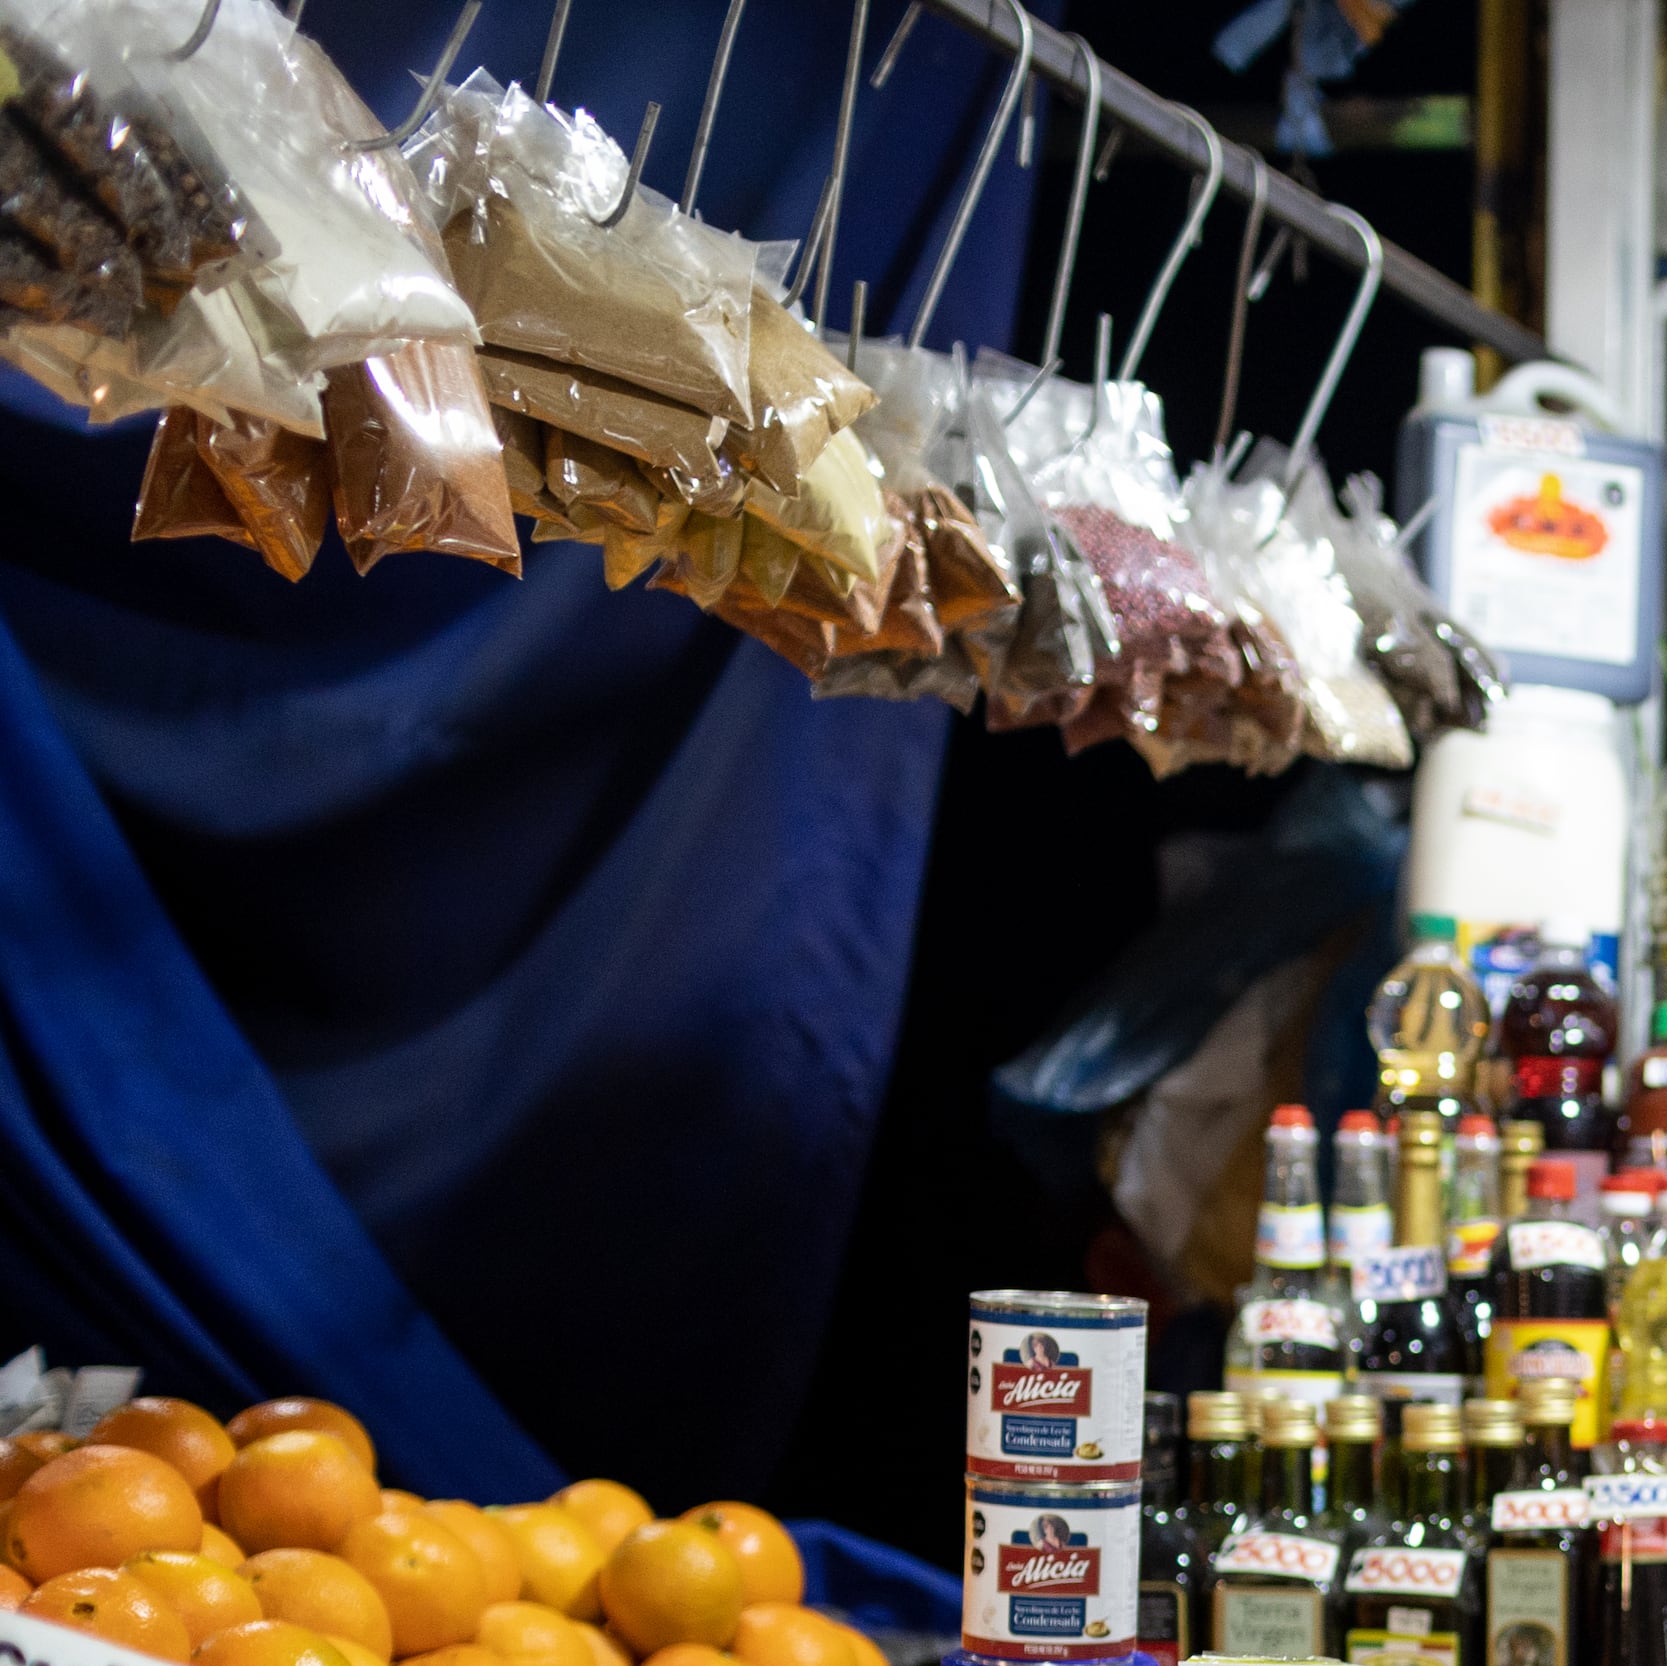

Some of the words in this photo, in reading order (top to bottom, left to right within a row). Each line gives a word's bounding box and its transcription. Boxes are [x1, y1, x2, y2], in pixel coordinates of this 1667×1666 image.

[1003, 1372, 1082, 1405] Alicia
[1005, 1432, 1071, 1449] Condensada
[1011, 1552, 1090, 1588] Alicia
[1013, 1612, 1081, 1628] Condensada
